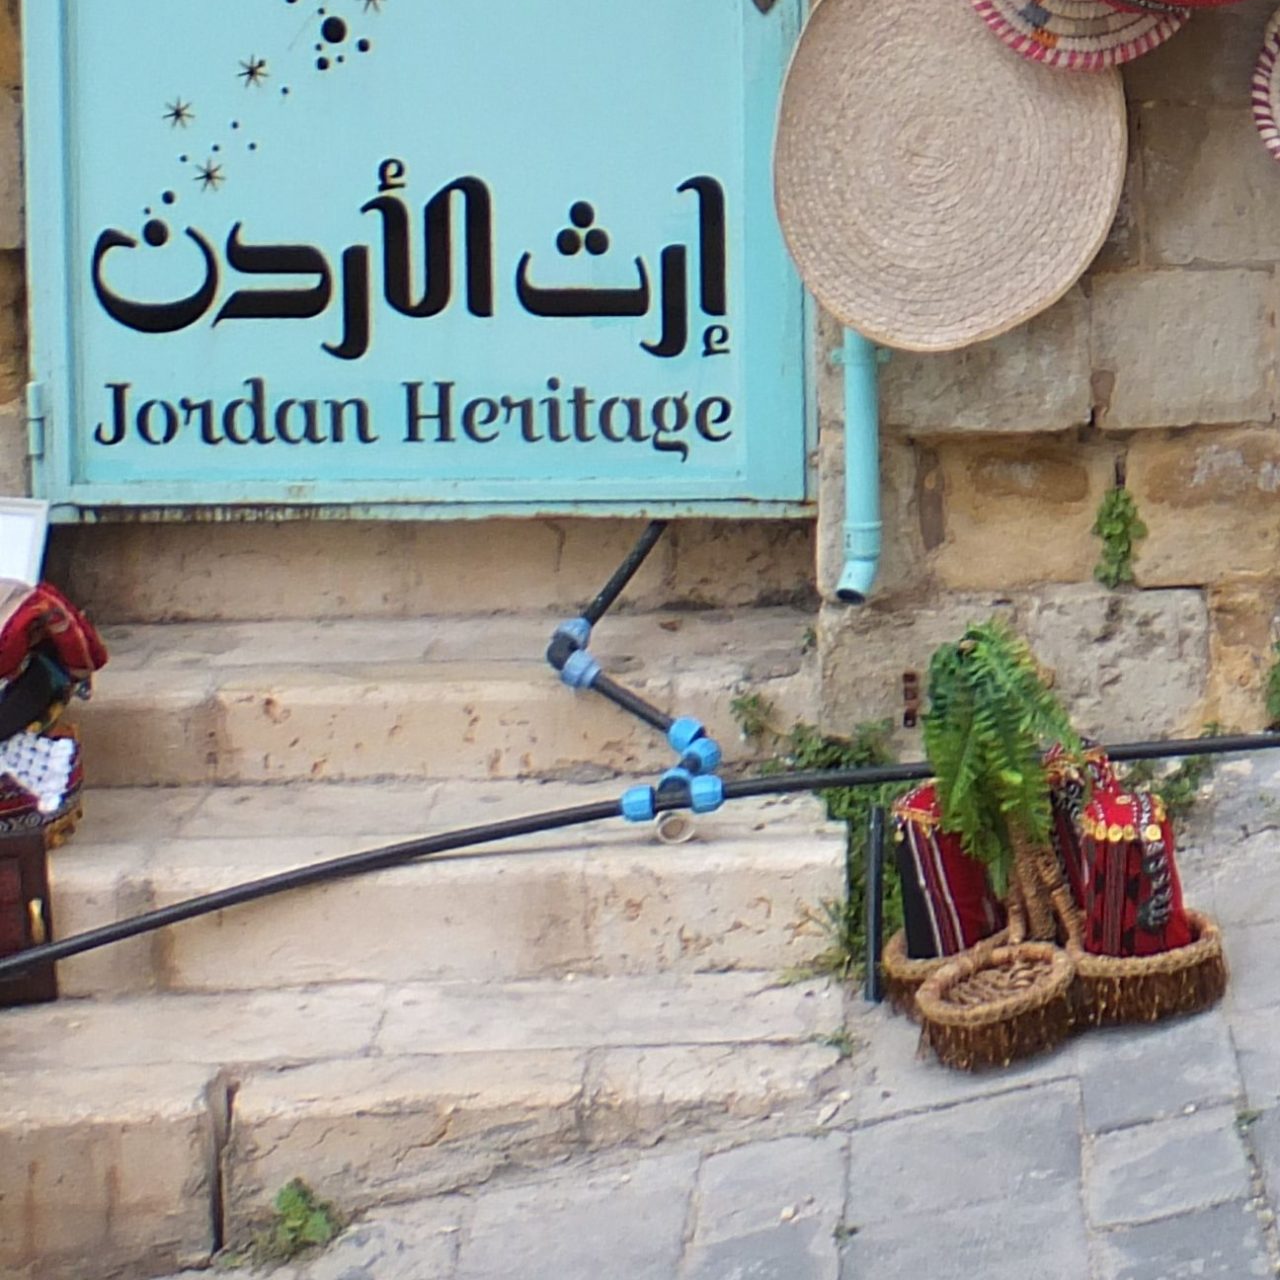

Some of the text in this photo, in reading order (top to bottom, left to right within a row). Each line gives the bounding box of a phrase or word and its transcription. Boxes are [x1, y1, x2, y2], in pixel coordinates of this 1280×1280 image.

[91, 158, 731, 361] إرث الأردن
[94, 377, 733, 463] Jordan Heritage
